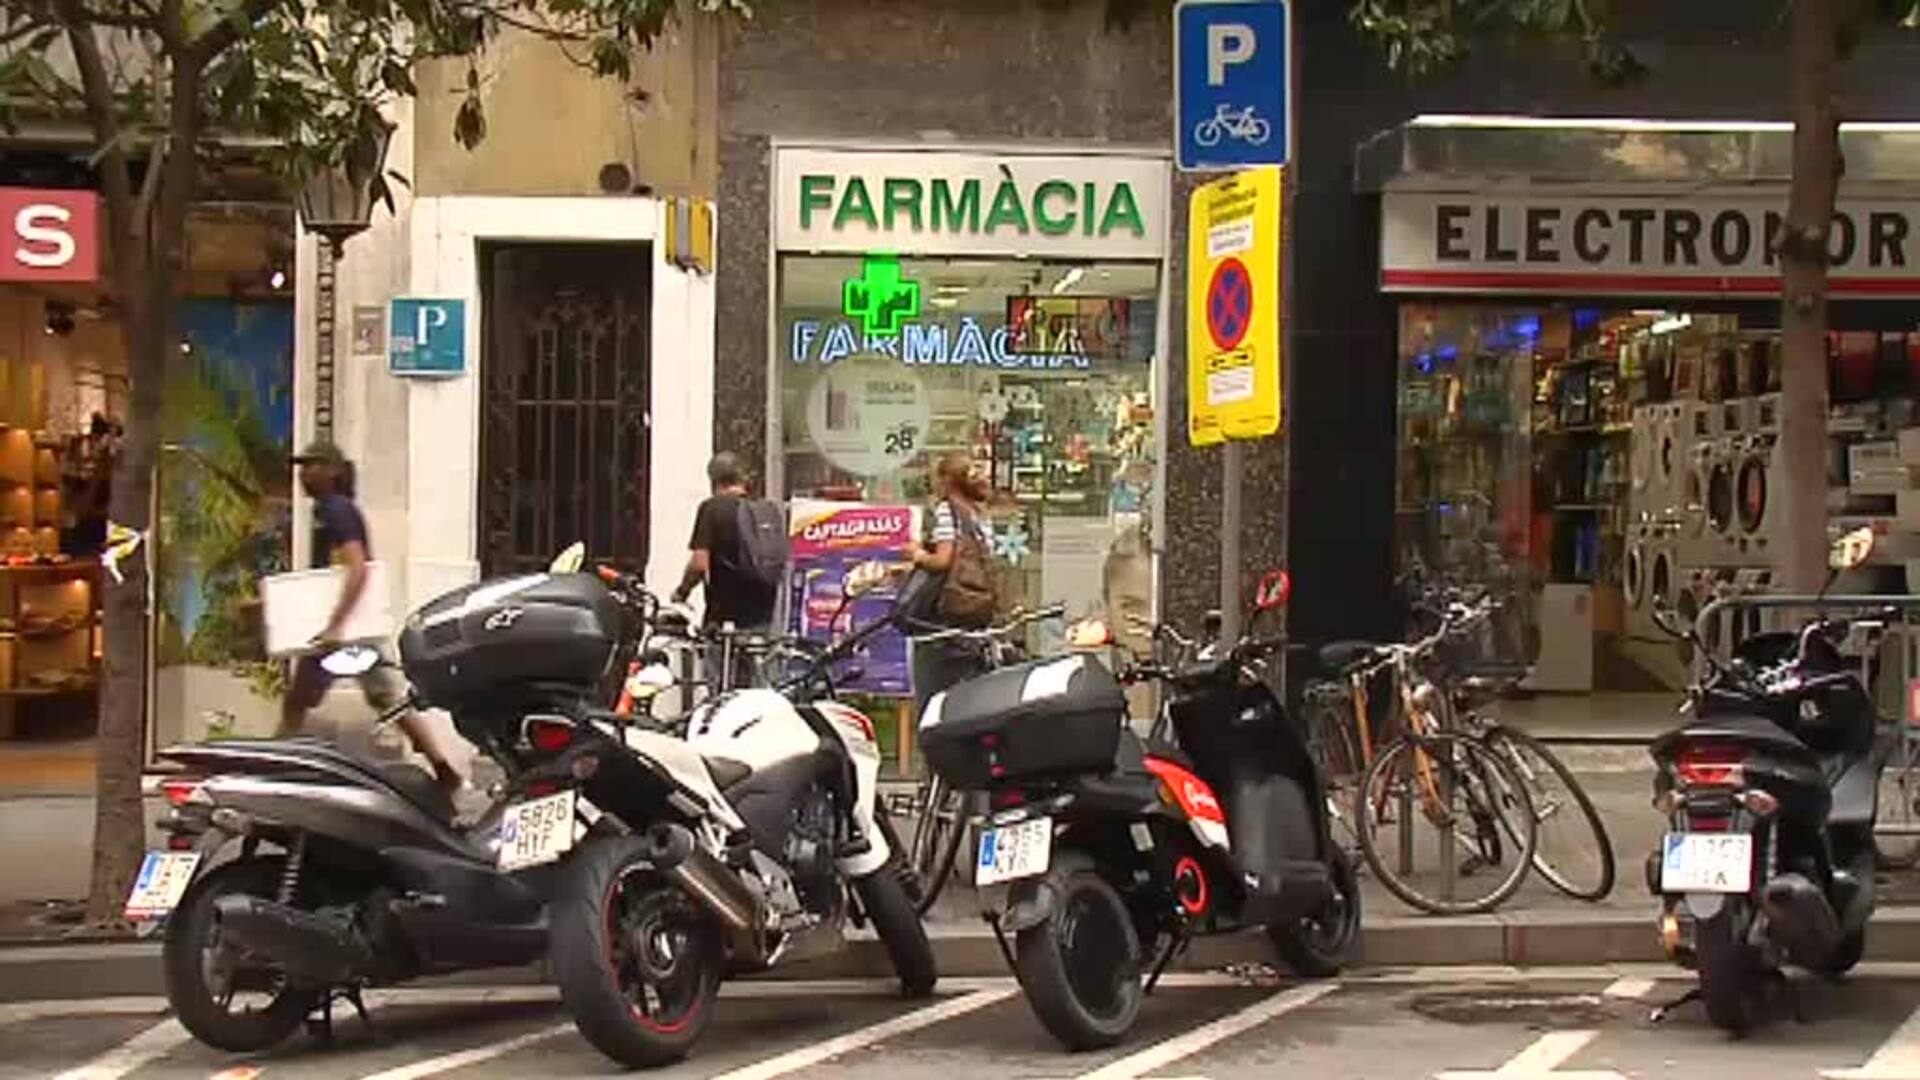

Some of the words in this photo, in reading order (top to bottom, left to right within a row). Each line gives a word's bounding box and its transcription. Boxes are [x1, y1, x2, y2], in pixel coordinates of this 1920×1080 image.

[1207, 24, 1256, 86] P
[799, 163, 1145, 237] FARMÀCIA
[14, 204, 76, 267] S
[416, 306, 447, 346] P
